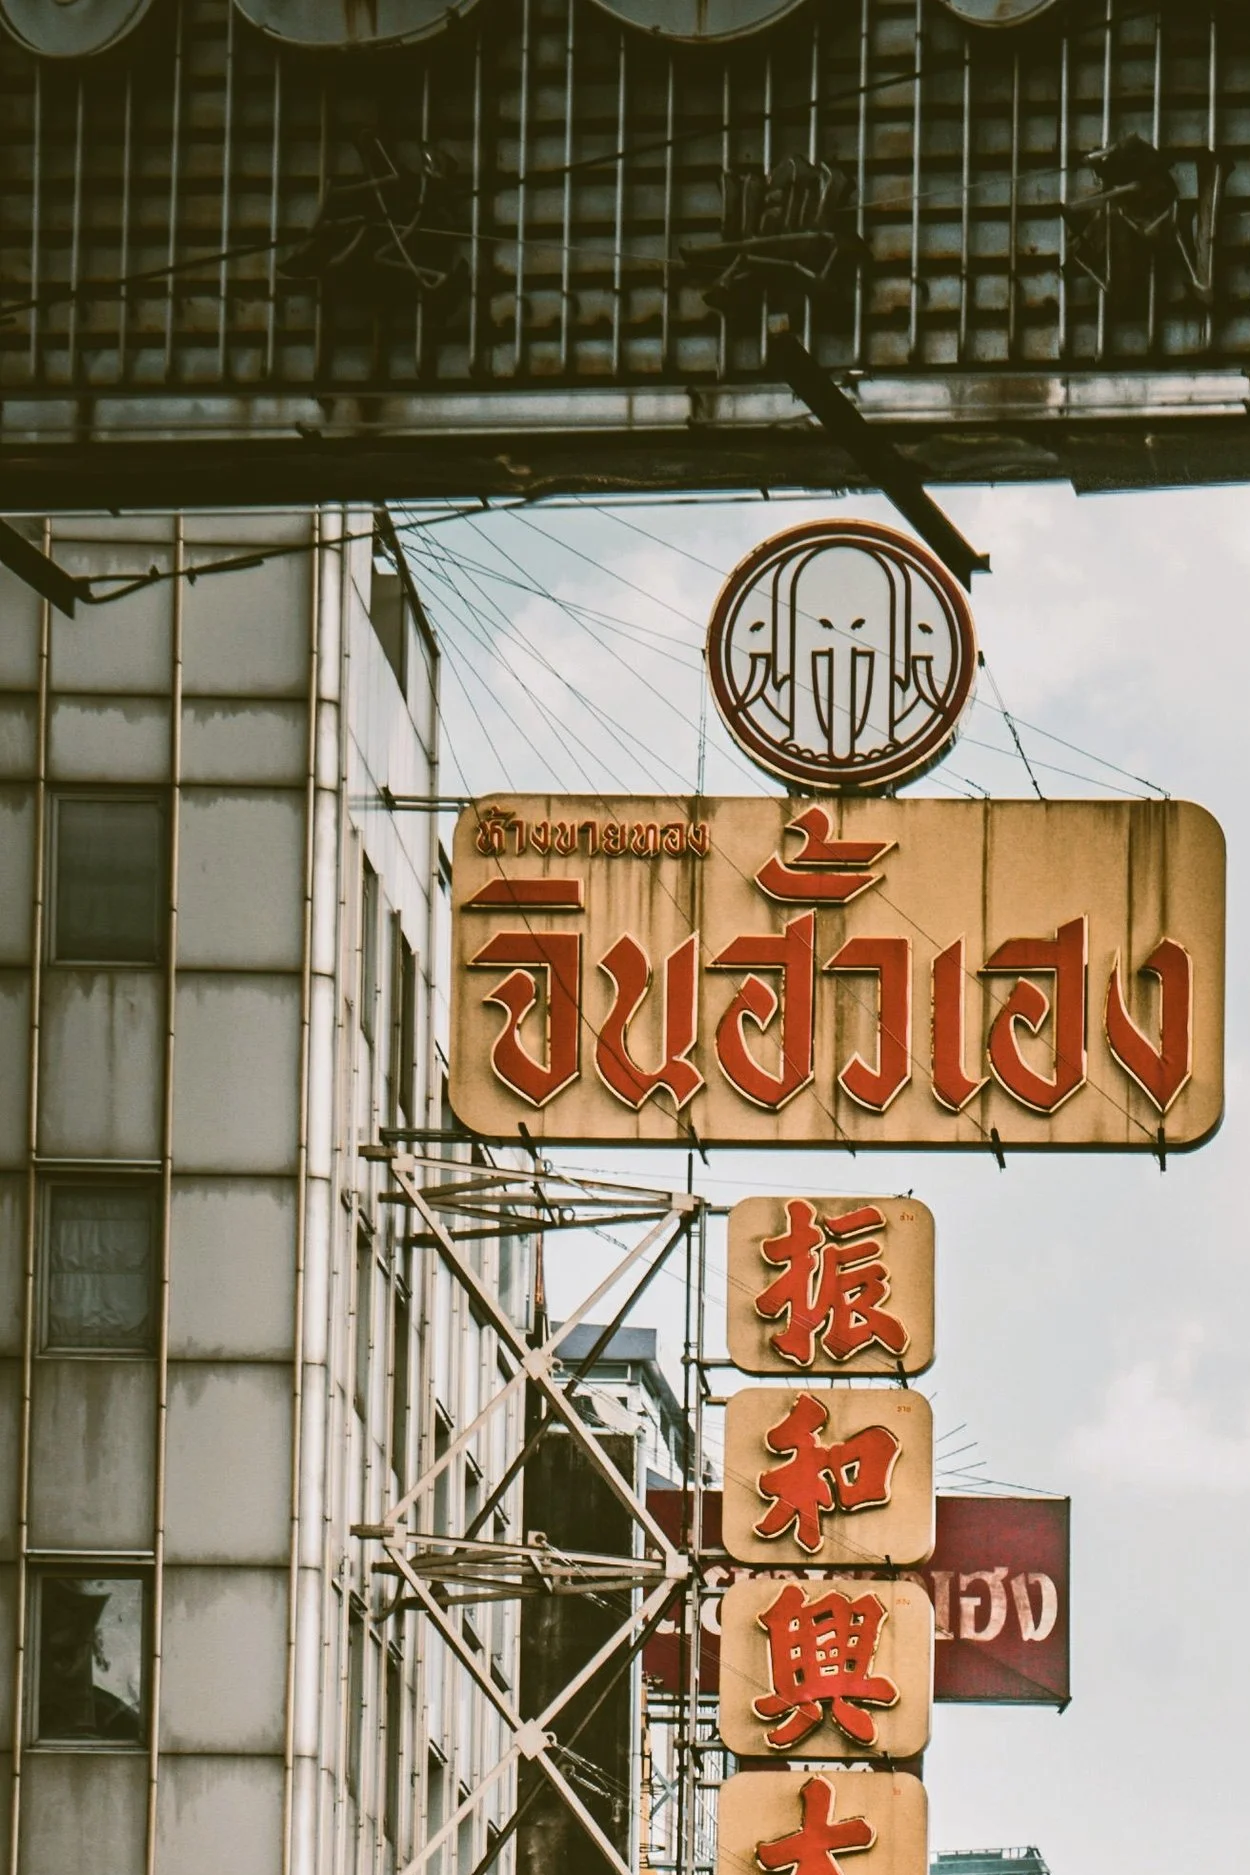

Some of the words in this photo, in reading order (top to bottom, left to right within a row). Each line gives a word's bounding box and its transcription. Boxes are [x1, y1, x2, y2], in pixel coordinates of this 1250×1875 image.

[474, 806, 711, 859] ห้างขายทอง
[462, 805, 1195, 1115] จินฮั้วเฮง
